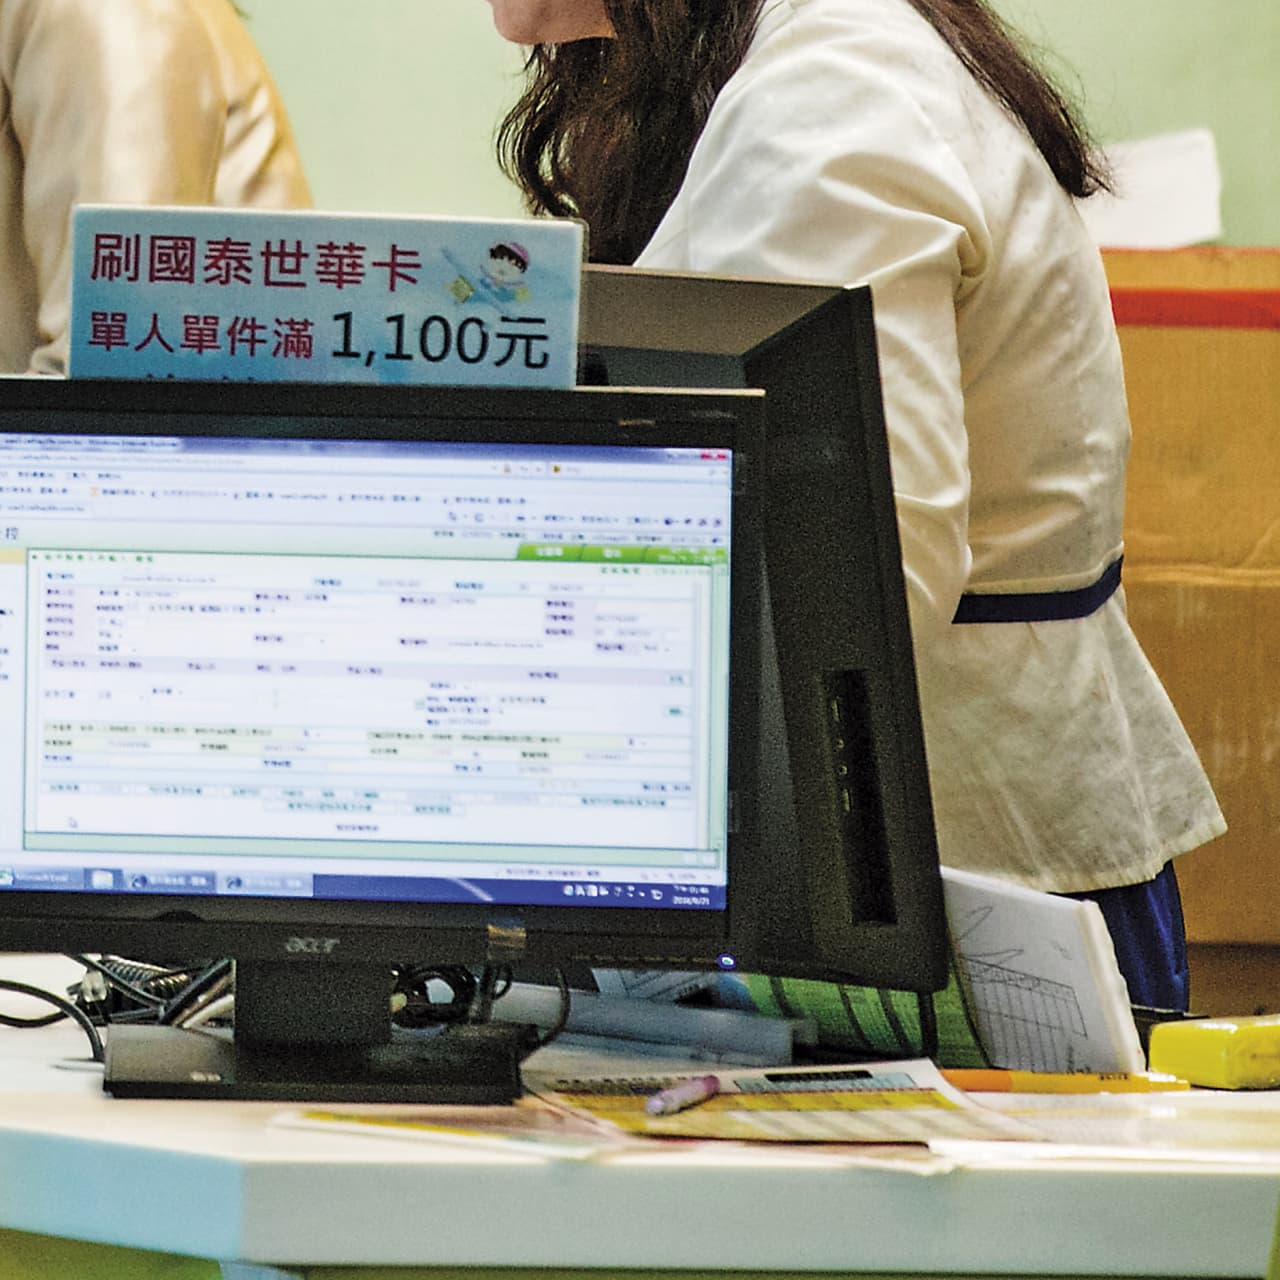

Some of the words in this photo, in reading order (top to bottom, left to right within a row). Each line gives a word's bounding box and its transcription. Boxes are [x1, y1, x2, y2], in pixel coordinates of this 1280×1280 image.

[90, 232, 423, 293] 刷國泰世華卡
[87, 310, 316, 361] 單人單件滿
[331, 310, 551, 370] 1,100元
